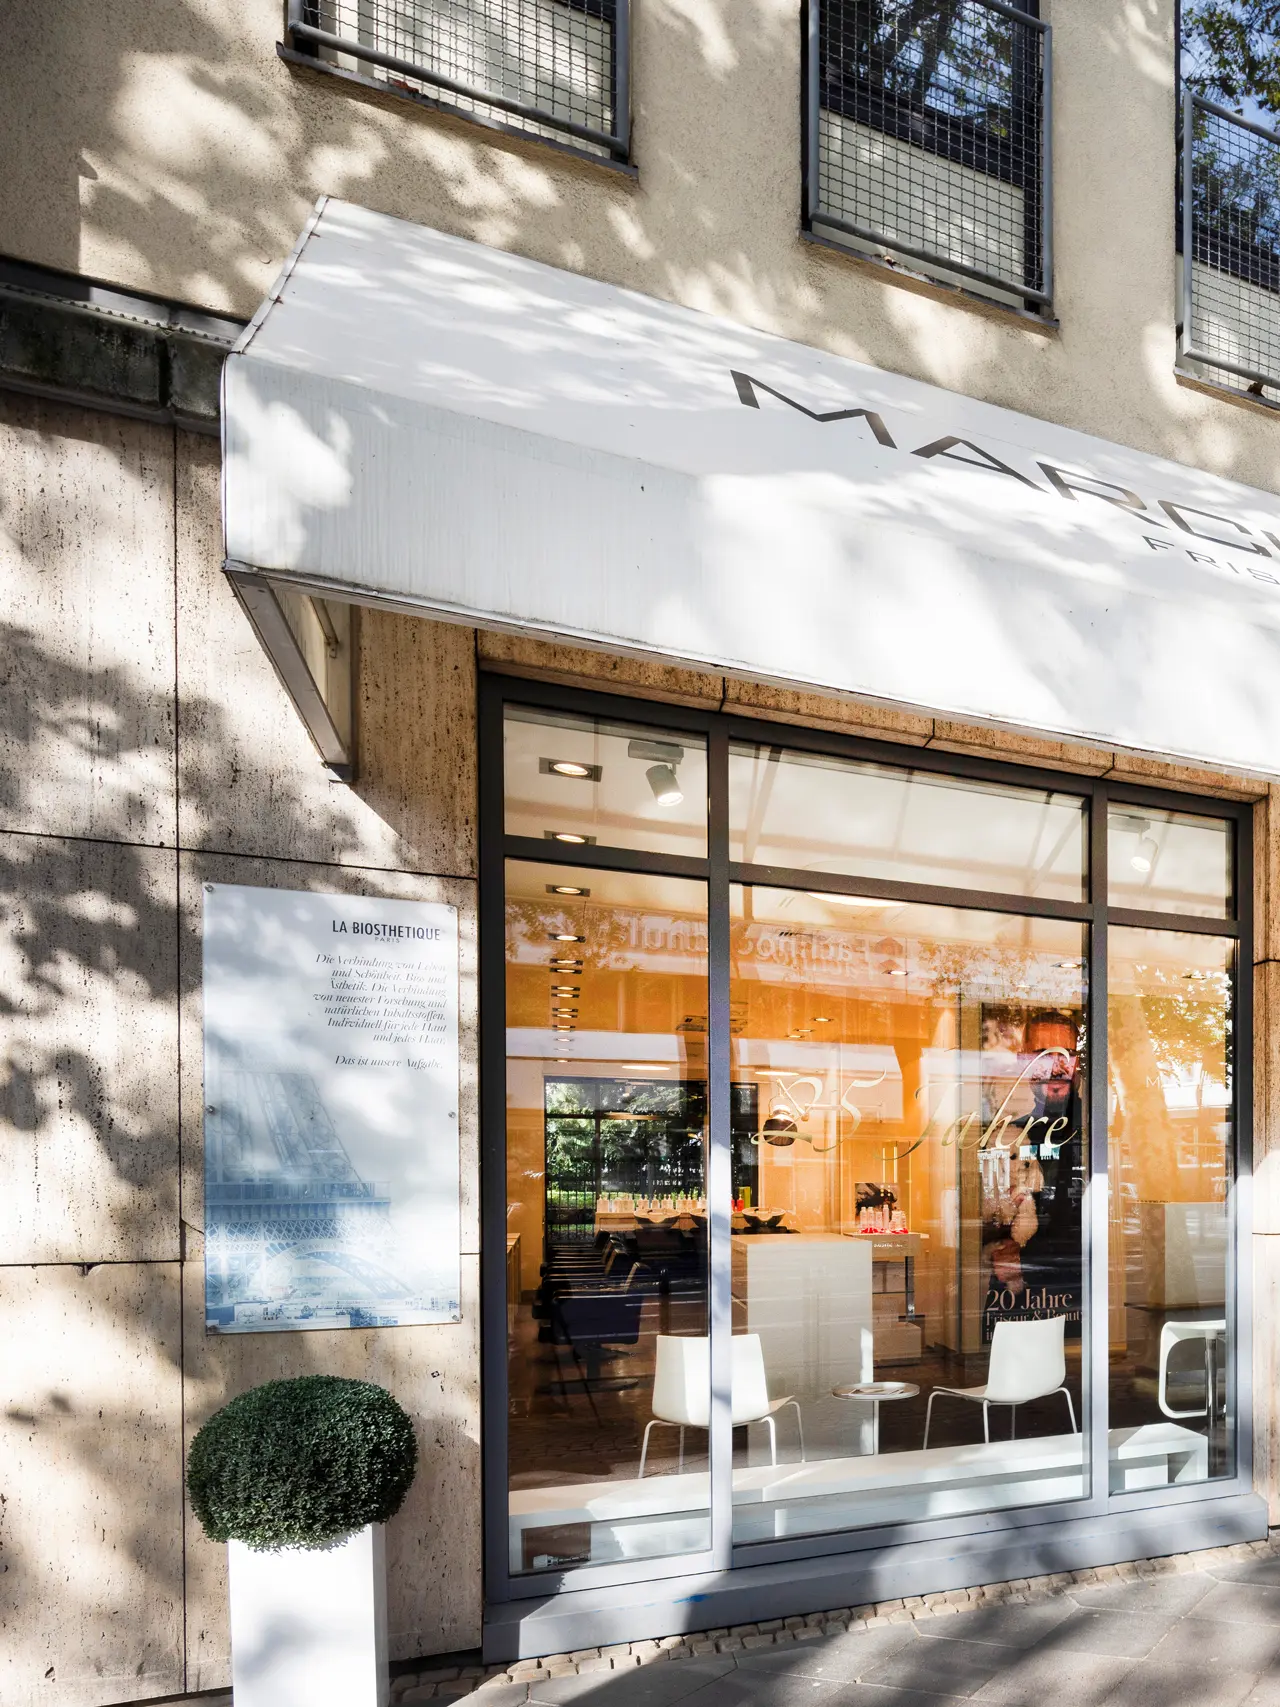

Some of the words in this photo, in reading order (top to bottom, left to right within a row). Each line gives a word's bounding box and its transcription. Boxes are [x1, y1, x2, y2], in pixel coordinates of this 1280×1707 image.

[332, 920, 348, 933] LA
[352, 921, 441, 940] BIOSTHETIQUE
[316, 954, 335, 964] Die
[335, 1055, 356, 1065] Das
[357, 1056, 369, 1065] ist
[370, 1059, 402, 1067] unsere
[751, 1069, 887, 1153] 25
[868, 1046, 1078, 1161] Jahre
[986, 1289, 1015, 1311] 20
[1020, 1287, 1073, 1310] Jahre
